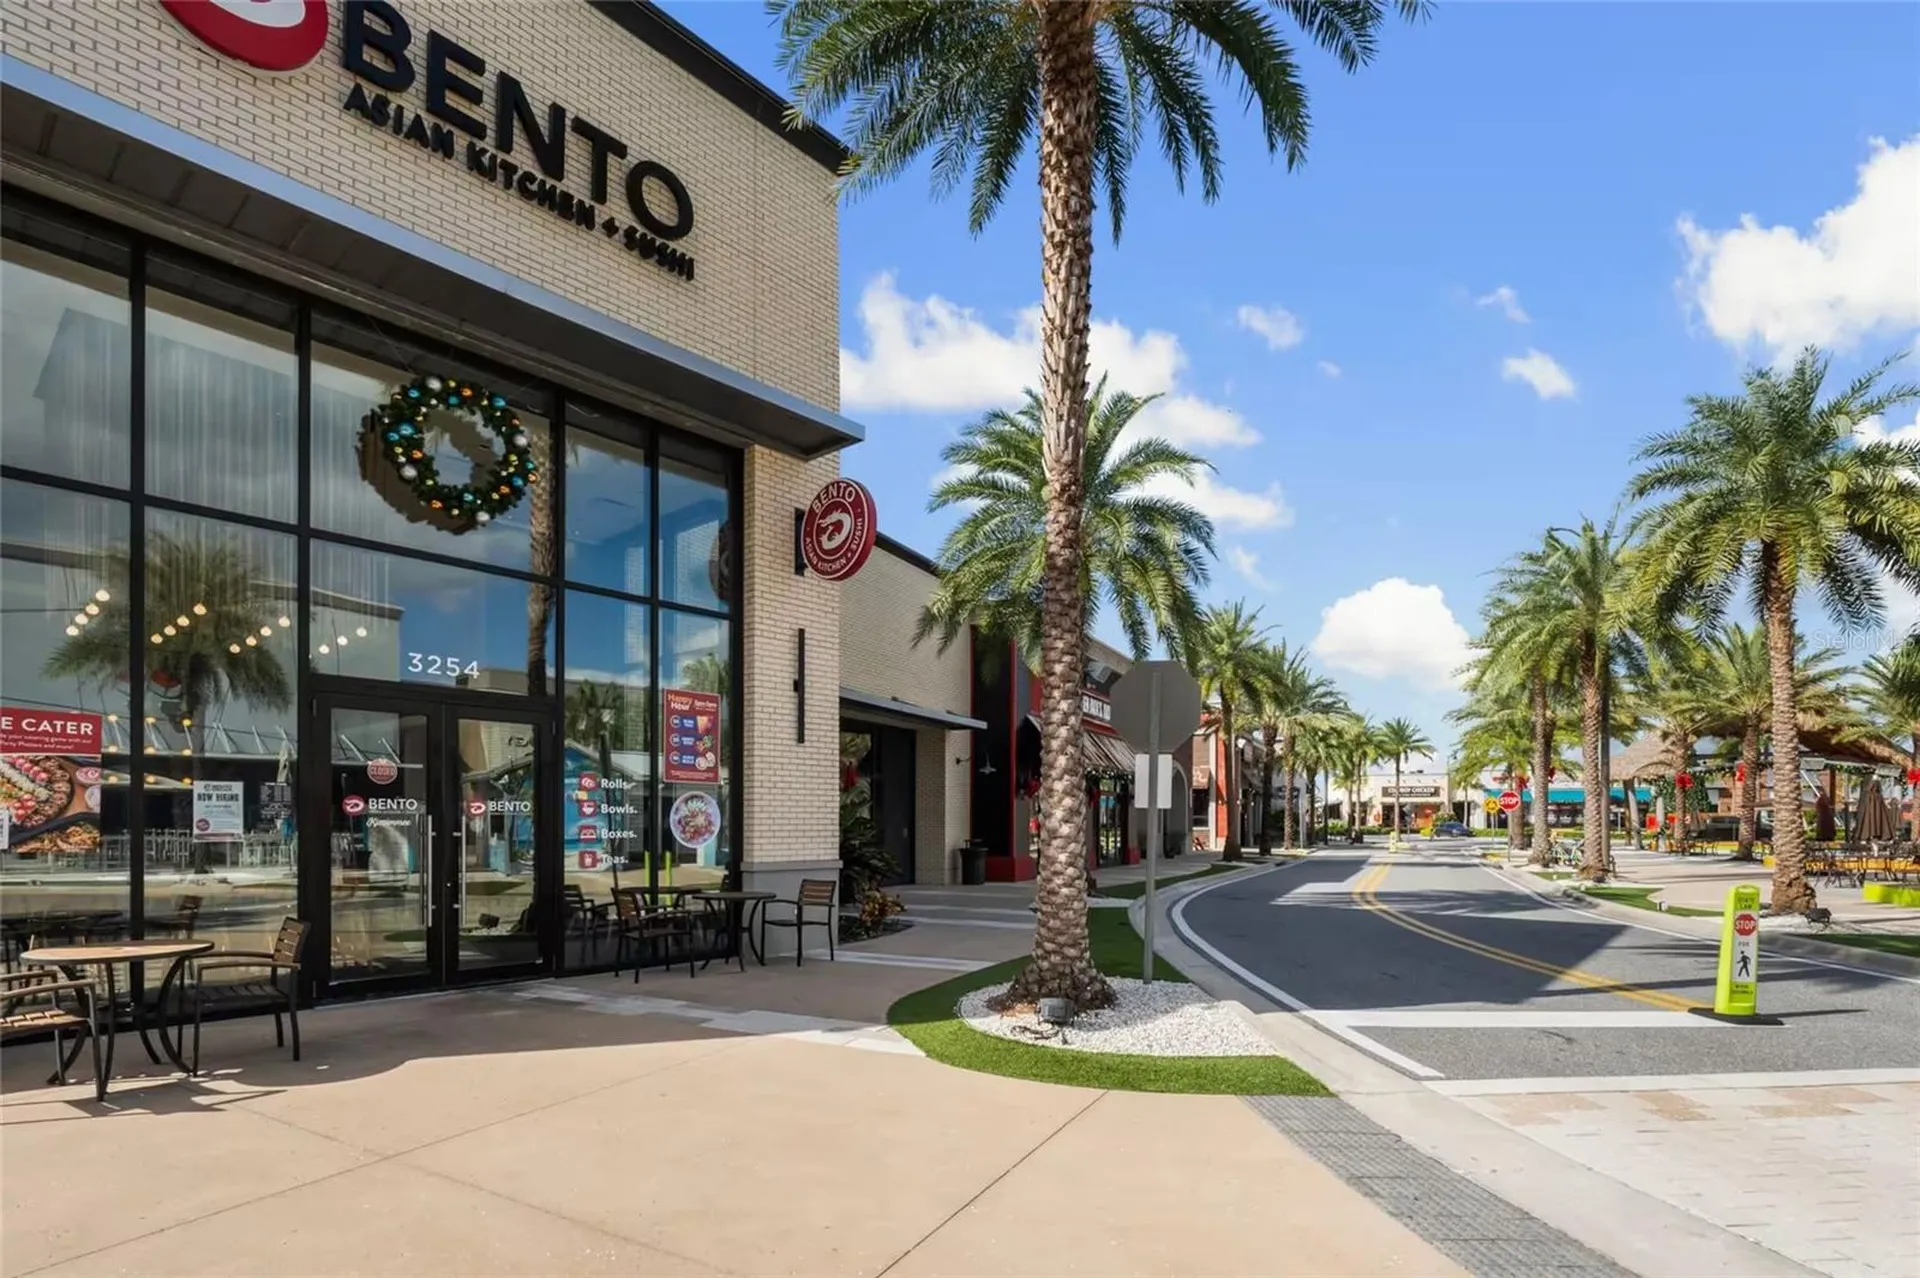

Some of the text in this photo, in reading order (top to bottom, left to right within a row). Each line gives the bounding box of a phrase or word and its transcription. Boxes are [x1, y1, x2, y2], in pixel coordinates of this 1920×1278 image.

[341, 0, 695, 241] BENTO
[342, 82, 455, 161] ASIAN
[465, 139, 596, 231] KITCHEN
[623, 224, 696, 281] SUSHI
[812, 483, 856, 513] BENTO
[817, 558, 847, 573] KITCHEN
[851, 517, 863, 552] SUSHI
[407, 652, 480, 678] 3254
[21, 718, 94, 736] CATER
[368, 797, 418, 811] BENTO
[489, 801, 531, 812] BENTO
[1499, 796, 1519, 805] STOP
[601, 803, 638, 814] Bowls.
[601, 828, 638, 839] Boxes.
[601, 853, 629, 864] Teas.
[1735, 919, 1756, 930] STOP
